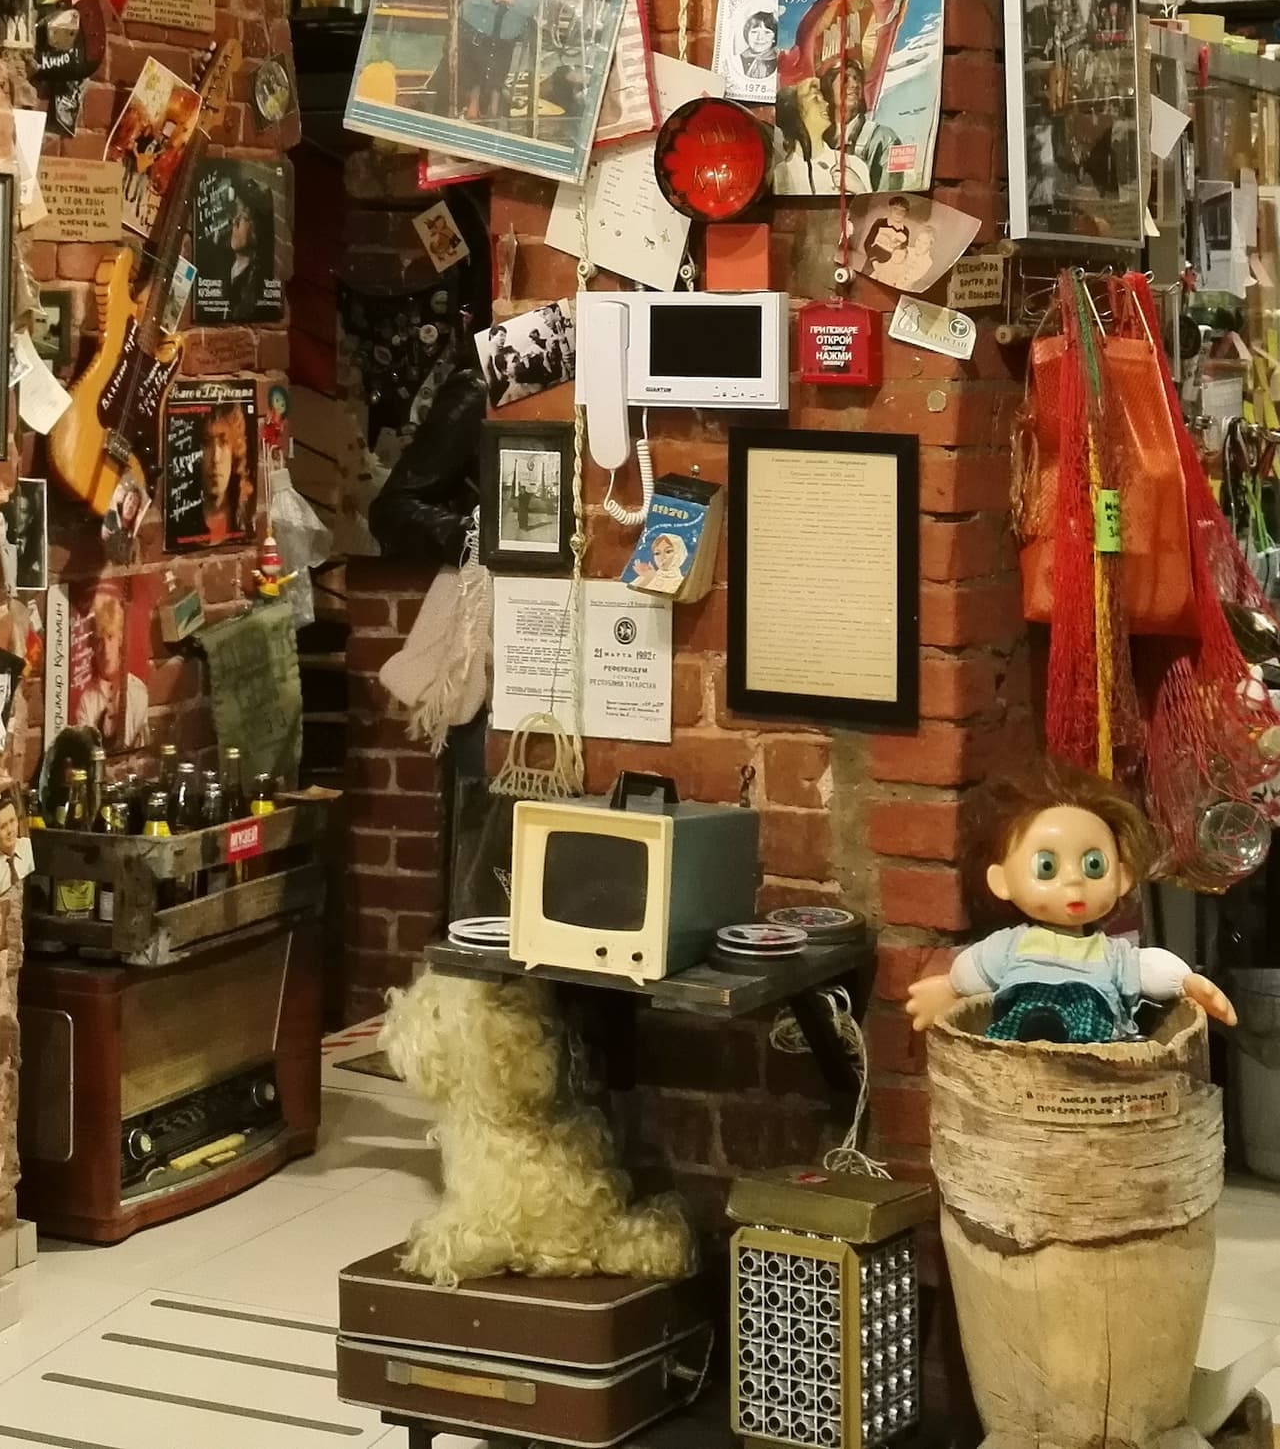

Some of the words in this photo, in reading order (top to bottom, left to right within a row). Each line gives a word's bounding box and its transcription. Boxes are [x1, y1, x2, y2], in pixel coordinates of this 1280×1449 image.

[810, 325, 827, 334] ПРИ
[827, 325, 859, 335] ПОЖАРЕ
[816, 335, 853, 345] ОТКРОЙ
[816, 352, 852, 361] НАЖМИ
[53, 602, 63, 667] Кузьмин
[594, 647, 603, 658] 21
[603, 665, 648, 674] РЕФЕРЕНДУМ
[625, 680, 656, 690] ТАТАРСТАН
